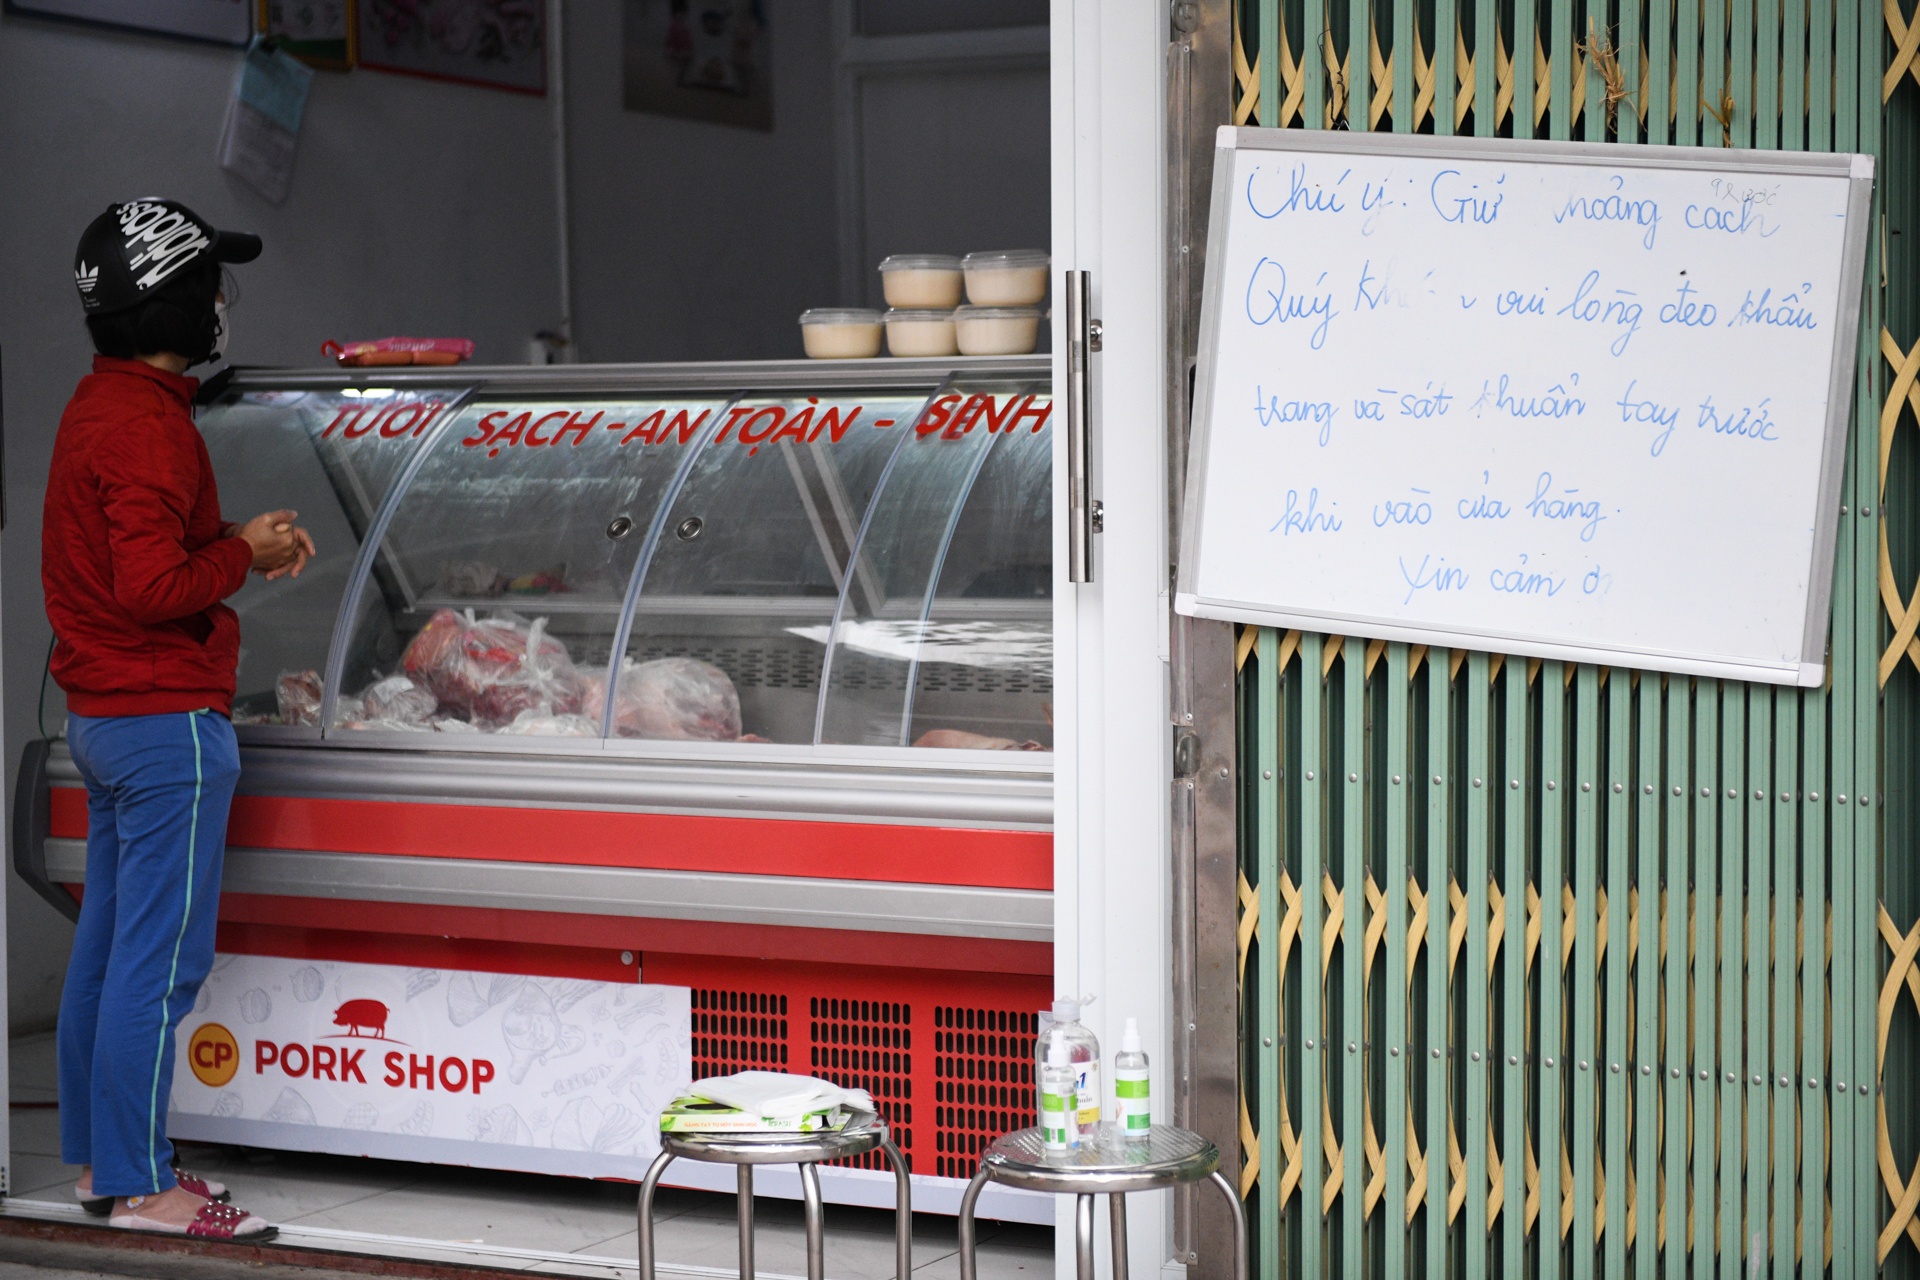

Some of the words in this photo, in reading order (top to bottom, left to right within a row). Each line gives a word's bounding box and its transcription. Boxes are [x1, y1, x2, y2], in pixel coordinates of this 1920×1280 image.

[1246, 256, 1340, 351] Quý
[1659, 280, 1718, 328] đeo
[462, 411, 605, 459] SẠCH
[620, 409, 712, 446] AN
[1254, 384, 1340, 448] trang
[1400, 381, 1454, 420] sát
[1616, 379, 1681, 458] tay
[1269, 486, 1343, 537] khi
[1489, 553, 1566, 598] cảm
[193, 1040, 233, 1070] CP
[254, 1039, 367, 1085] PORK
[383, 1051, 496, 1095] SHOP
